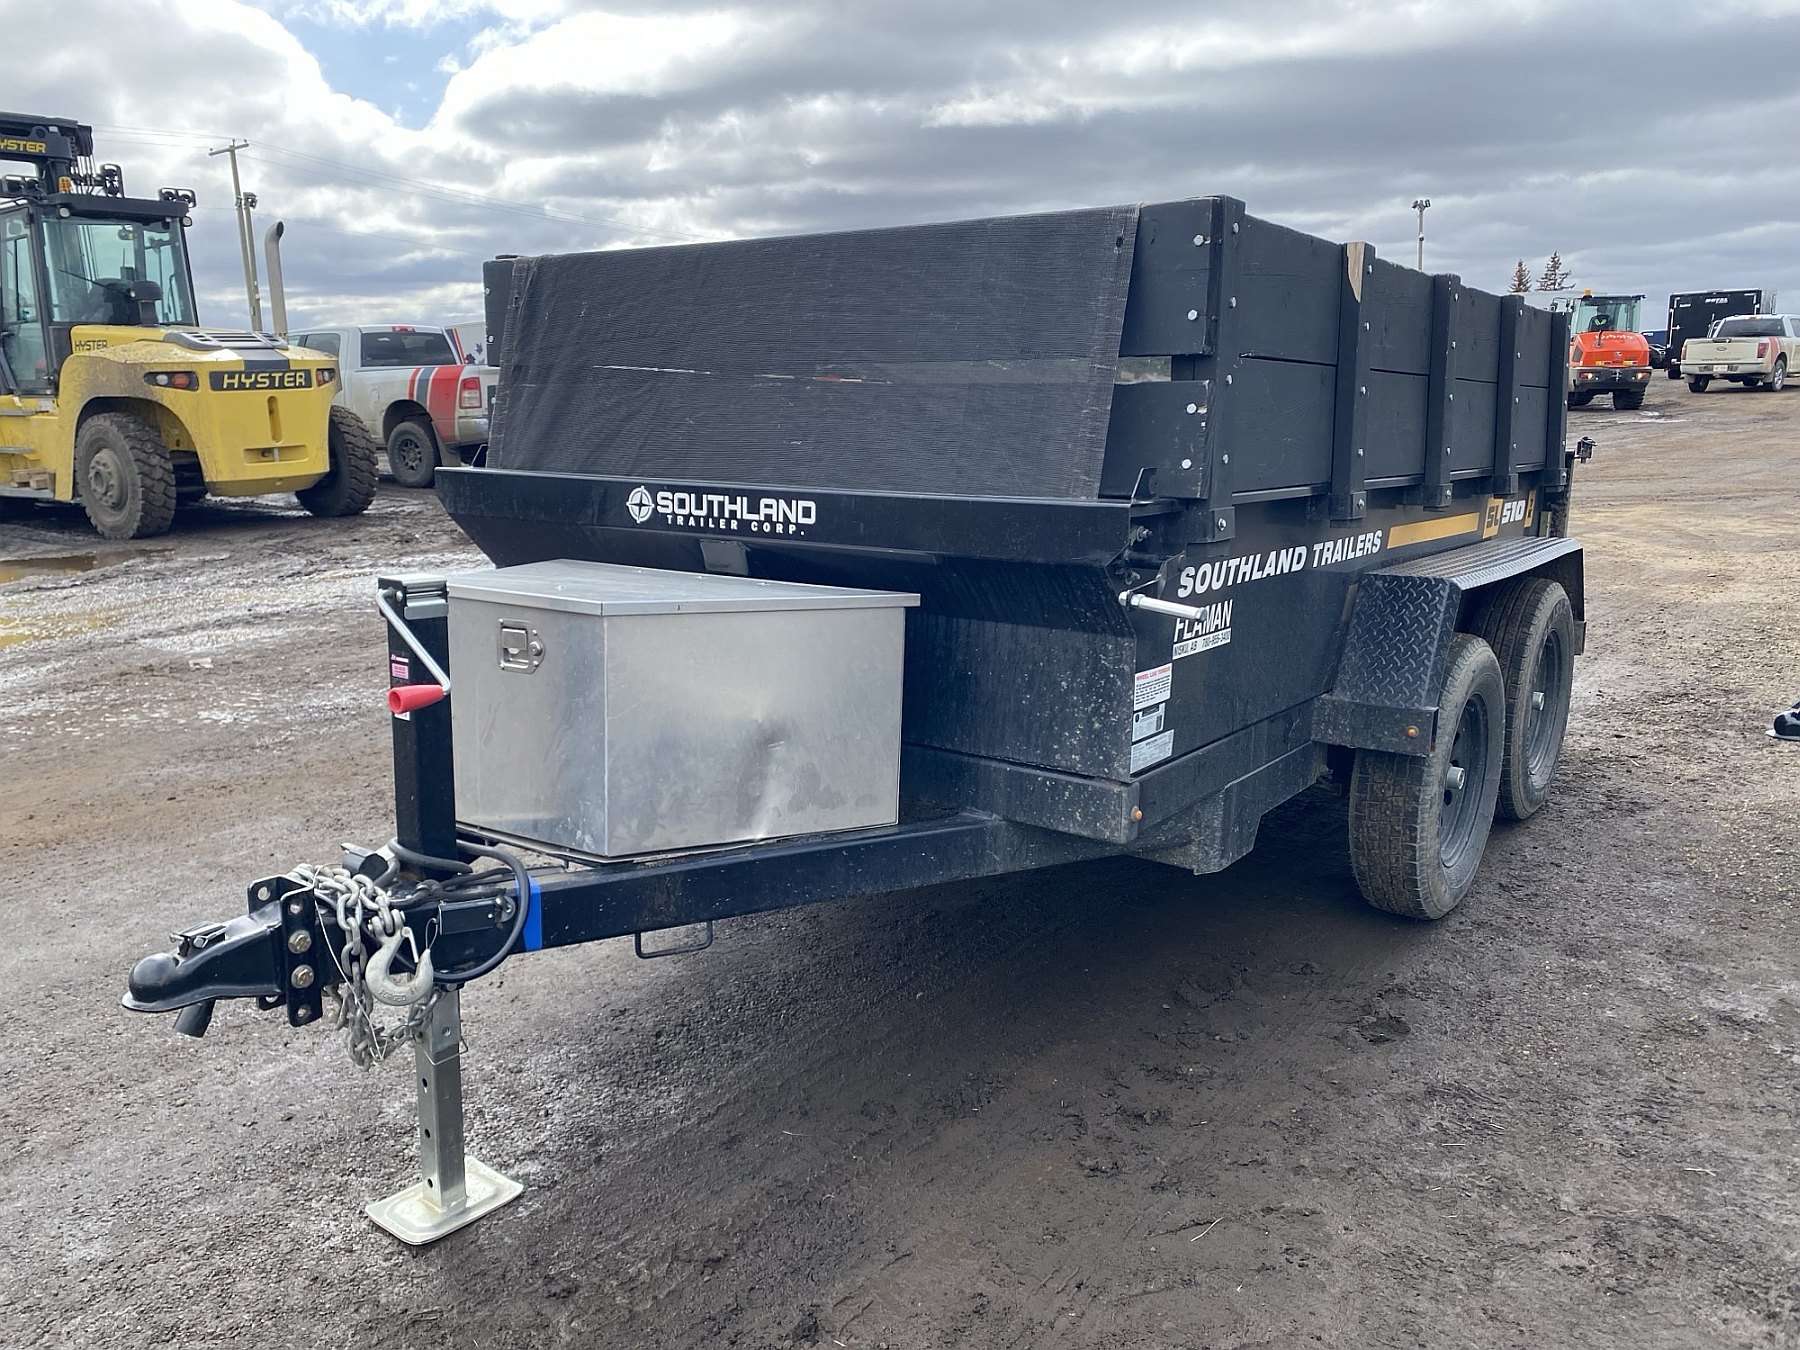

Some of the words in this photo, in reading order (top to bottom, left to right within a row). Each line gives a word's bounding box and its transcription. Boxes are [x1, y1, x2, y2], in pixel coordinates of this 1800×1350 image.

[74, 339, 108, 351] HYSTER
[222, 371, 306, 389] HYSTER
[656, 491, 816, 524] SOUTHLAND
[666, 514, 738, 530] TRAILER
[750, 520, 805, 536] CORP.
[1177, 546, 1307, 598] SOUTHLAND
[1312, 530, 1383, 568] TRAILERS
